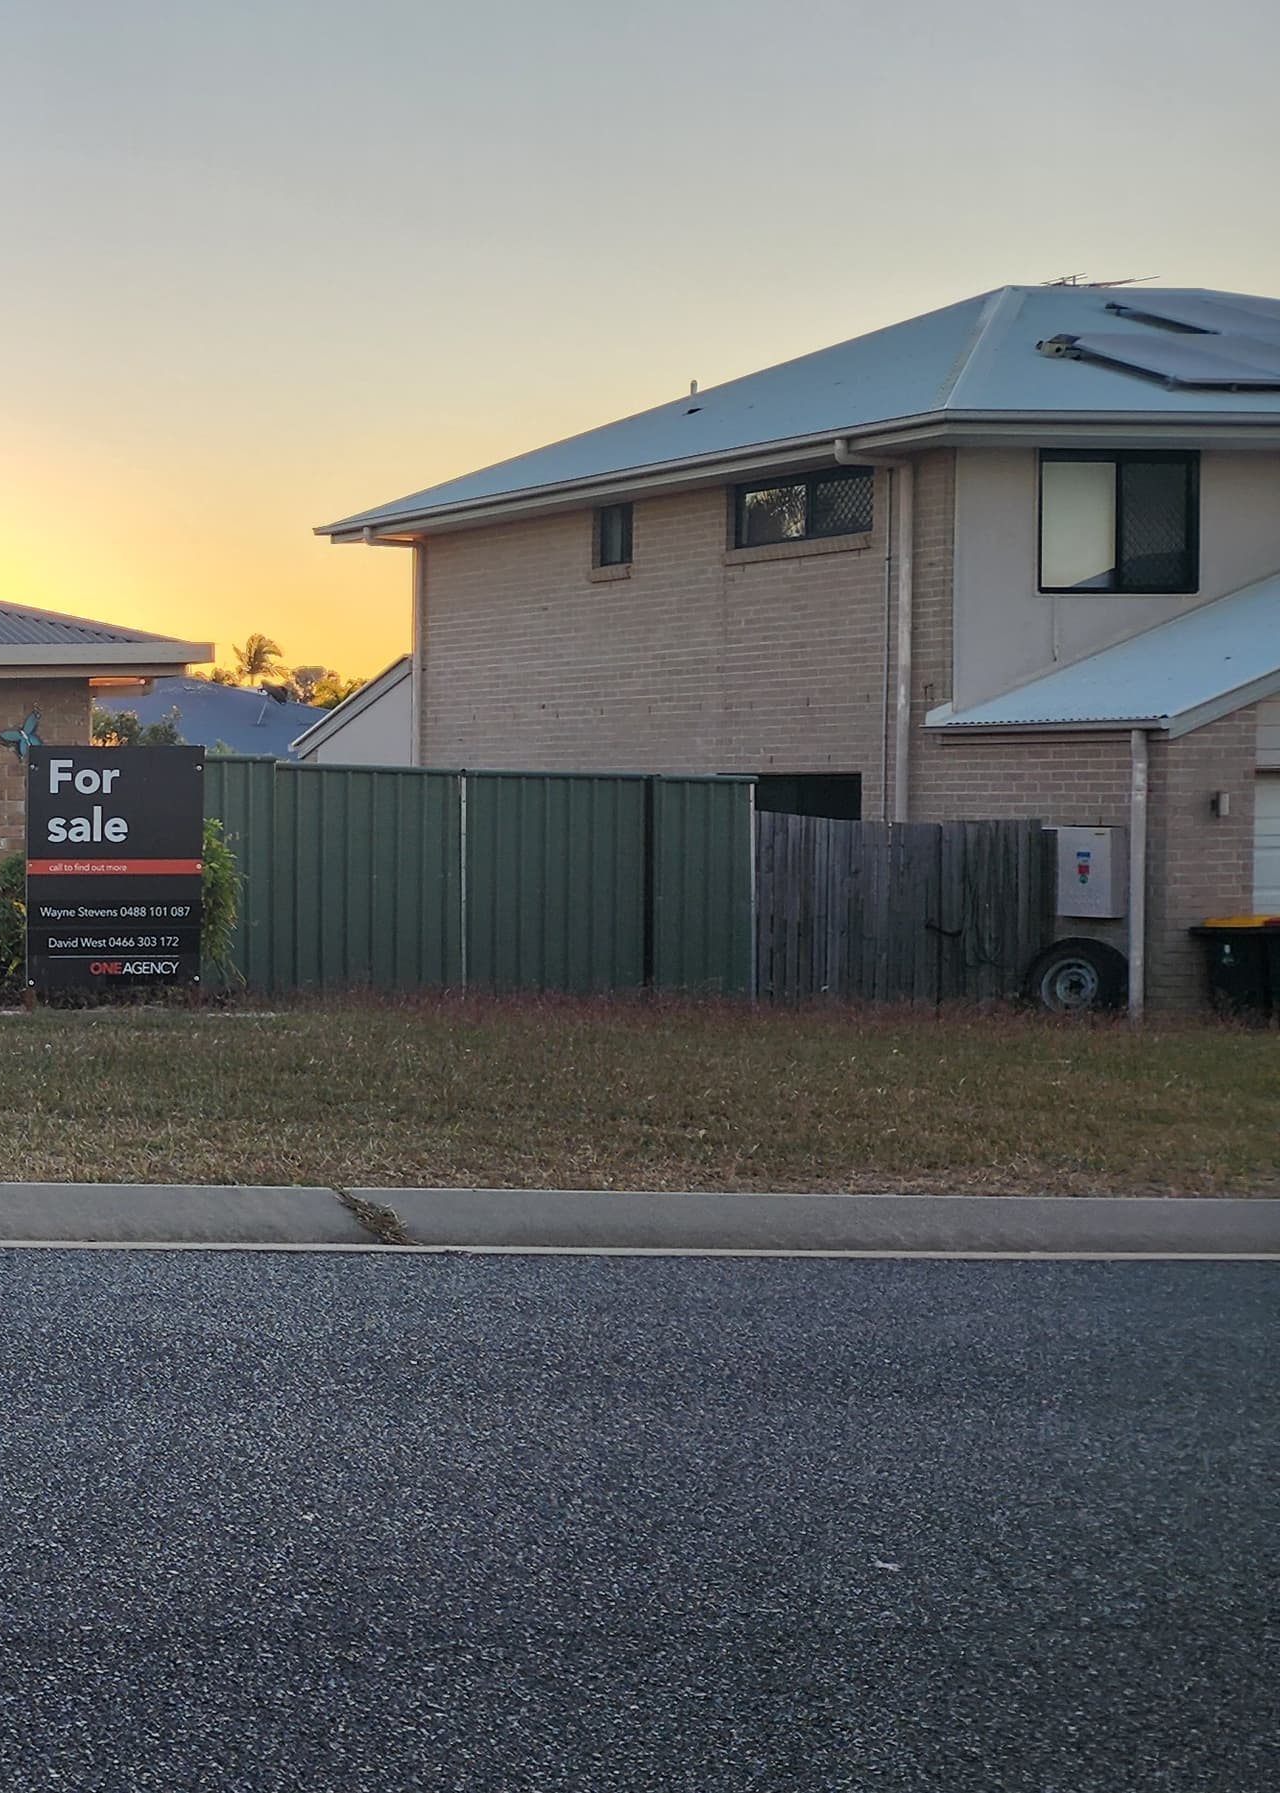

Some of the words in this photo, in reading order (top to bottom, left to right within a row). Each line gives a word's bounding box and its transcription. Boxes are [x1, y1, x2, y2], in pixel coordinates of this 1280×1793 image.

[49, 759, 121, 794] For
[47, 805, 129, 843] sale
[48, 863, 63, 872] call
[64, 864, 73, 872] to
[74, 862, 90, 872] find
[91, 864, 105, 872] out
[106, 864, 128, 872] more
[40, 906, 76, 920] Wayne
[78, 906, 118, 918] Stevens
[120, 906, 147, 917] 0488
[150, 906, 167, 917] 101
[170, 906, 190, 917] 087
[48, 937, 78, 949] David
[80, 937, 107, 948] West
[108, 936, 135, 947] 0466
[137, 936, 157, 947] 303
[160, 936, 180, 947] 172
